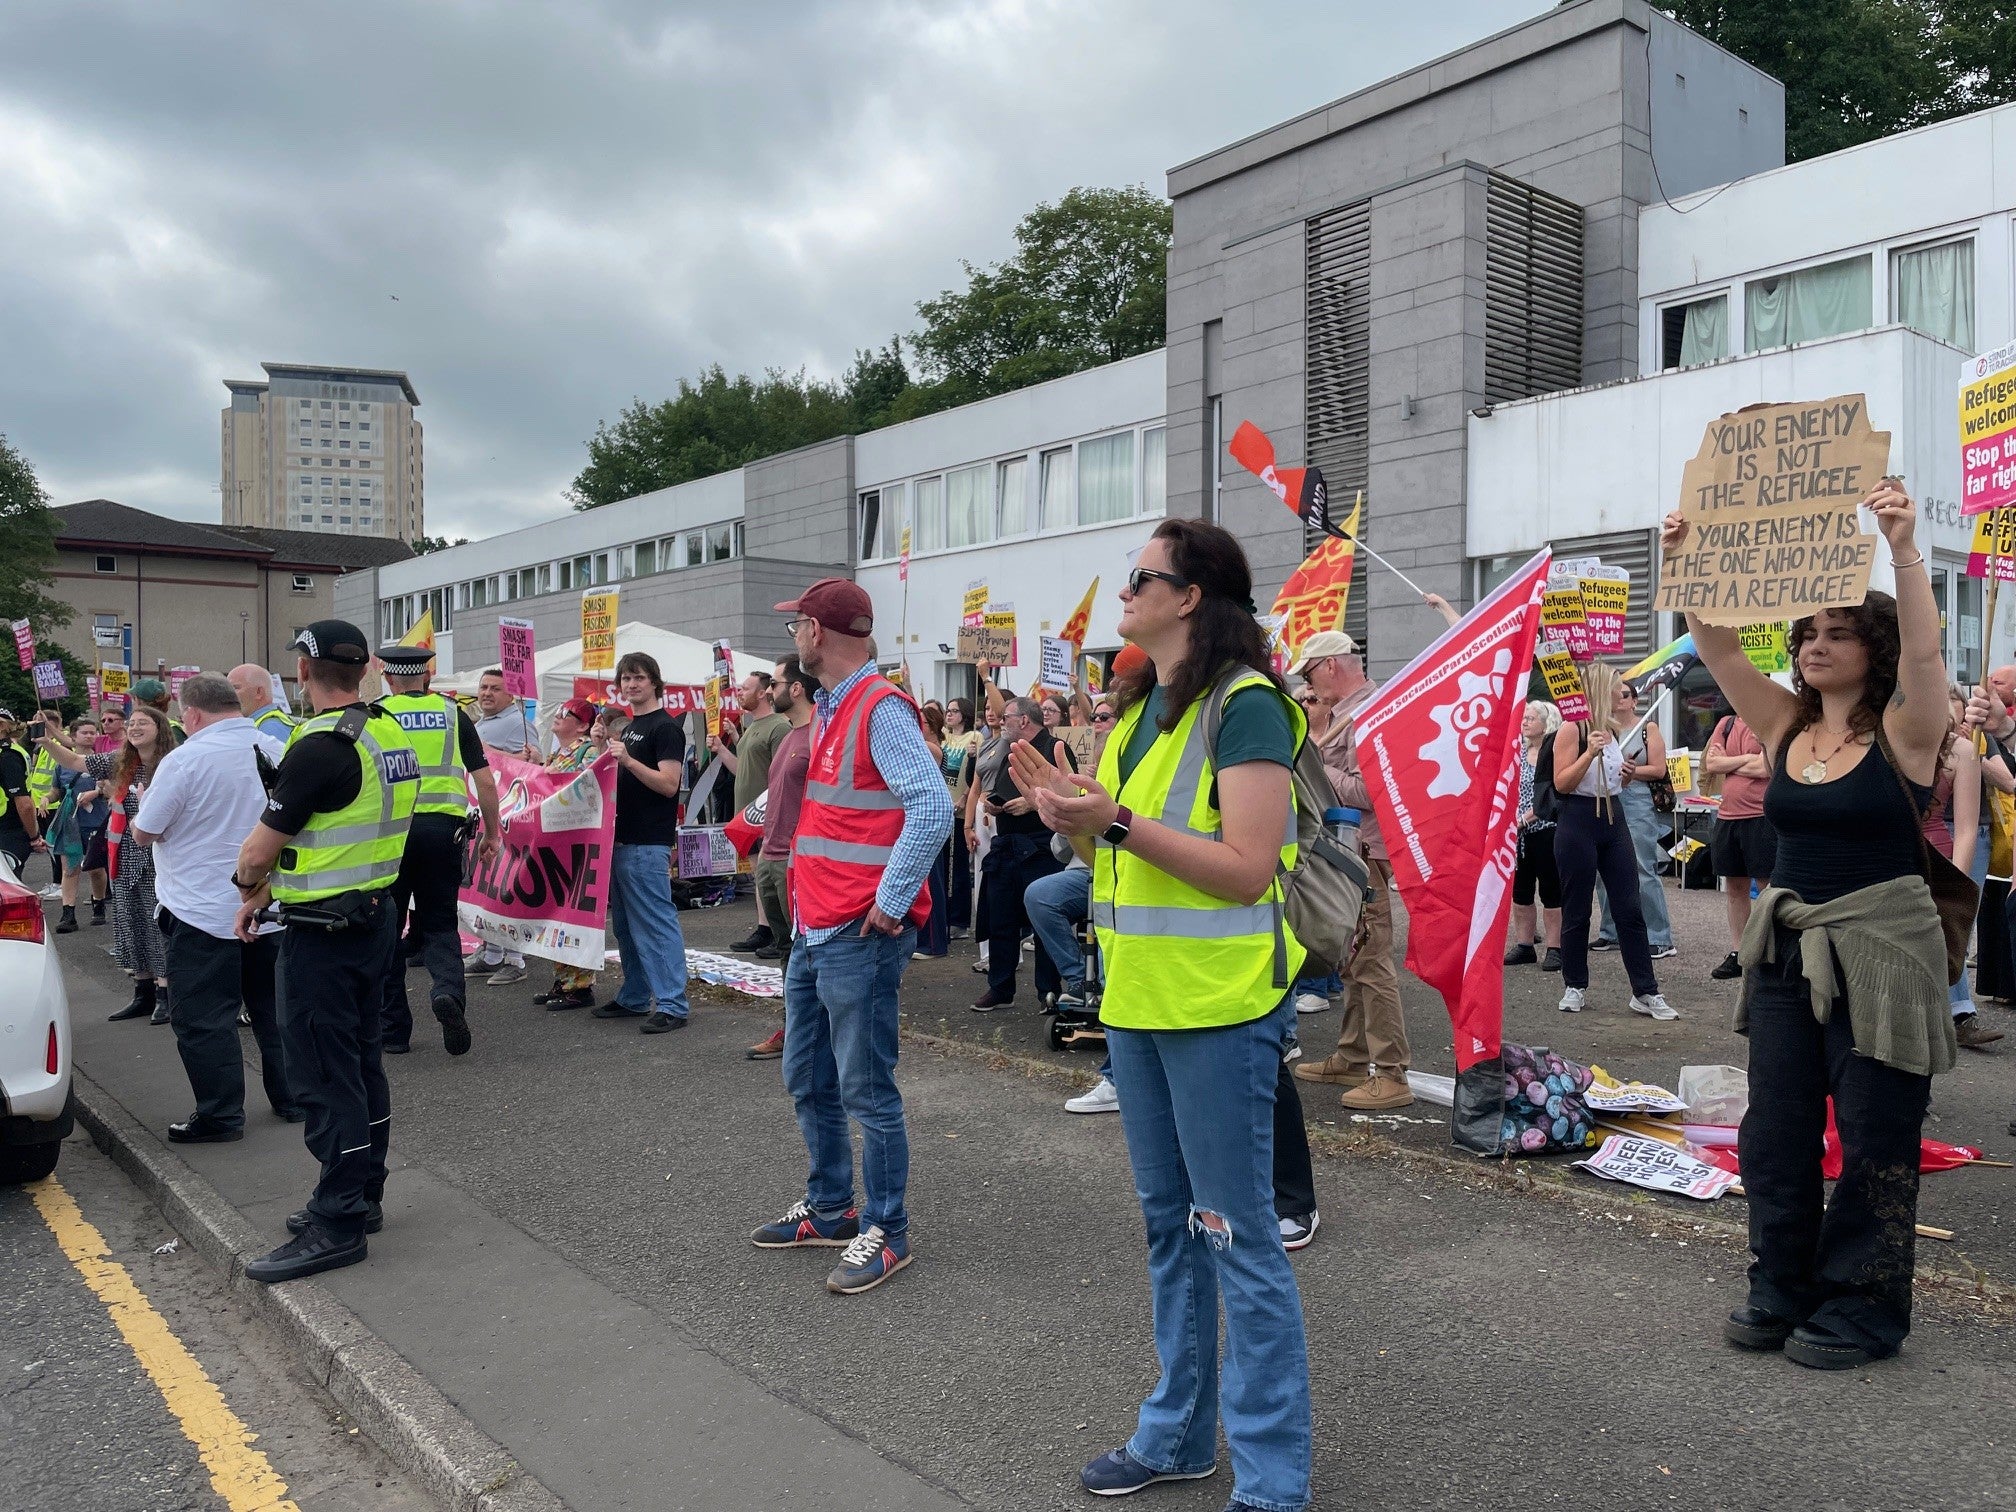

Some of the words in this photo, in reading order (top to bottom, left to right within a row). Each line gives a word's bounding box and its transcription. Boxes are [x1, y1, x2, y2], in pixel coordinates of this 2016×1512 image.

[1966, 377, 2016, 410] Refugee
[1965, 403, 2016, 435] welcom
[1711, 418, 1767, 458] YOUR
[1775, 402, 1860, 445] ENEMY
[1736, 454, 1758, 481] IS
[1777, 440, 1831, 473] NOT
[1966, 445, 1999, 471] Stop
[2004, 434, 2016, 458] th
[1967, 474, 1987, 496] far
[1992, 461, 2016, 490] righ
[1697, 482, 1745, 510] THE
[1756, 465, 1866, 506] REFUGEE,
[1697, 521, 1750, 550] YOUR
[1754, 511, 1833, 546] ENEMY
[1837, 513, 1857, 539] IS
[1666, 552, 1715, 578] THE
[1720, 549, 1760, 574] ONE
[1763, 546, 1804, 574] WHO
[1809, 543, 1871, 572] MADE
[1580, 581, 1627, 597] Refugees
[1662, 580, 1719, 608] THEM
[1722, 580, 1739, 608] A
[1745, 574, 1858, 608] REFUGEE.
[583, 598, 607, 613] SMASH
[583, 615, 611, 631] FASCISM
[984, 615, 1015, 627] Refugees
[1544, 609, 1583, 621] welcome
[1589, 617, 1603, 630] op
[1605, 616, 1621, 629] the
[502, 628, 527, 645] SMASH
[1547, 626, 1570, 640] Stop
[1572, 625, 1587, 637] the
[1740, 623, 1766, 635] MASH
[583, 637, 588, 650] &
[589, 632, 614, 648] RACISM
[976, 637, 1010, 648] HUMAN
[1596, 630, 1620, 645] right
[1741, 634, 1773, 648] ACISTS
[503, 643, 515, 658] THE
[517, 645, 532, 660] FAR
[1568, 639, 1589, 653] right
[36, 664, 56, 674] STOP
[504, 658, 525, 674] RIGHT
[37, 670, 62, 681] DAWN
[38, 678, 65, 688] RAIDS
[1554, 684, 1571, 696] our
[1373, 732, 1390, 771] Scottish
[1382, 766, 1402, 806] Section
[1394, 804, 1408, 817] of
[1399, 816, 1414, 835] the
[683, 843, 700, 851] DOWN
[683, 851, 694, 859] THE
[683, 859, 704, 868] SEXIST
[683, 867, 708, 876] SYSTEM
[1636, 1143, 1664, 1165] AND
